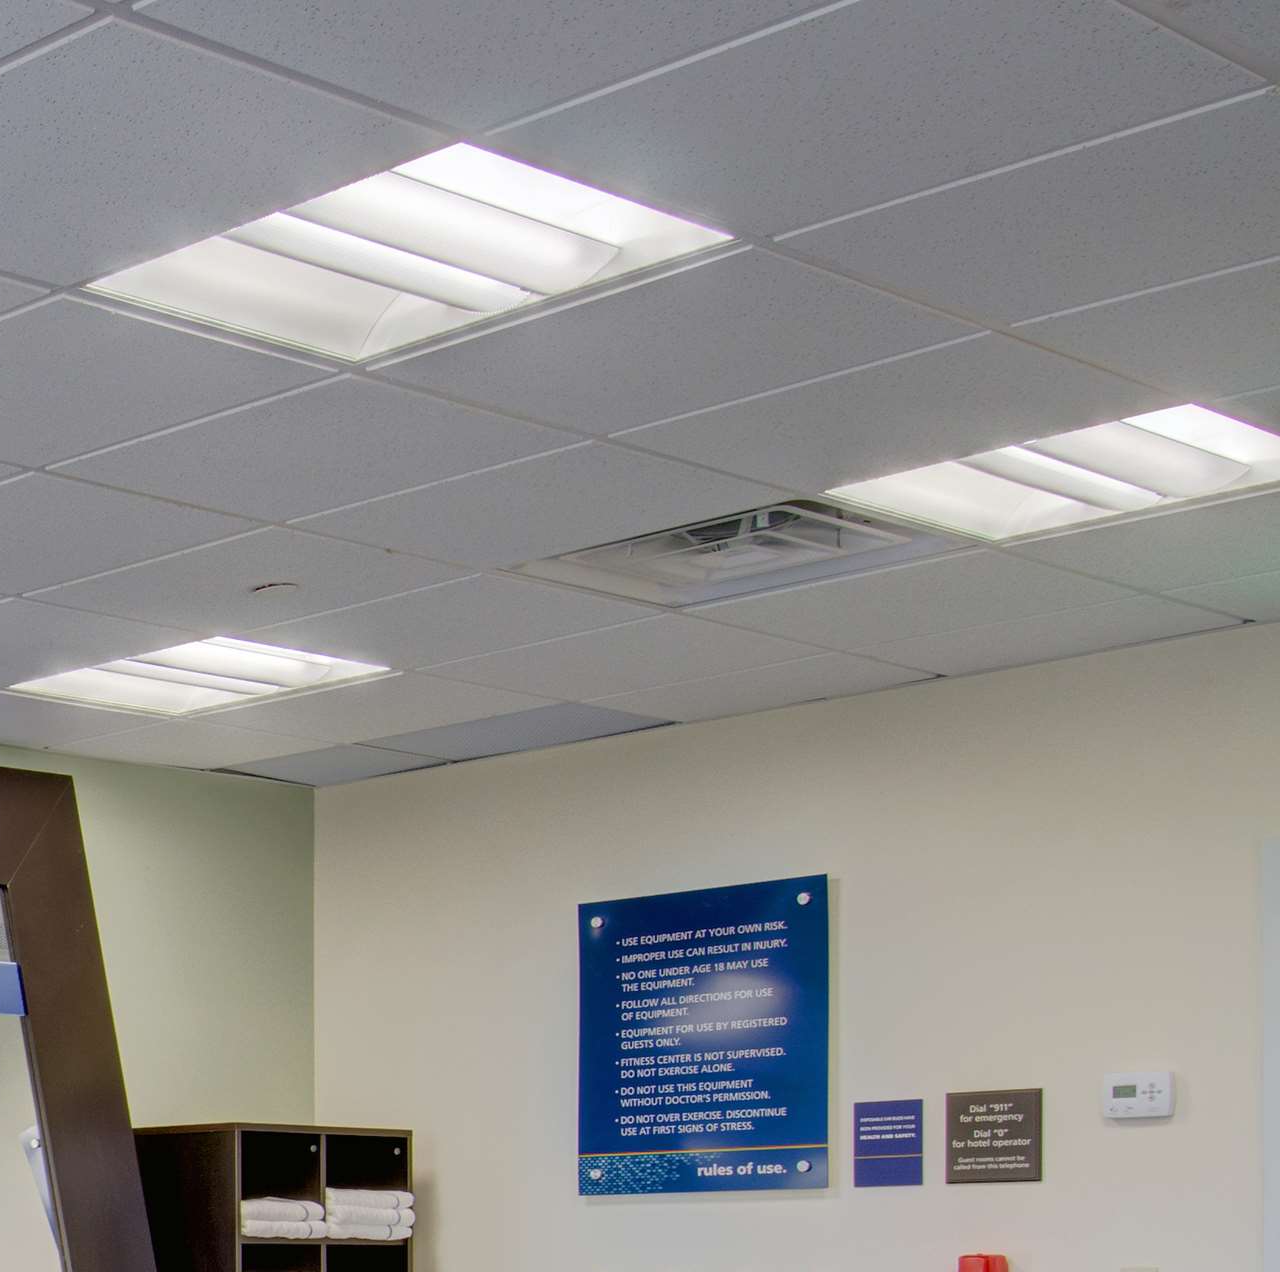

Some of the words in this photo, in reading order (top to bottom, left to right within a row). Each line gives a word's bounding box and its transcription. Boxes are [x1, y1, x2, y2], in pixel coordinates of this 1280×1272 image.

[622, 937, 639, 946] USE
[641, 931, 693, 945] EQUIPMENT
[695, 929, 707, 938] AT
[709, 927, 736, 937] YOUR
[737, 924, 762, 934] OWN
[764, 921, 788, 931] RISK.
[622, 951, 666, 964] IMPROPER
[668, 949, 685, 959] USE
[686, 947, 705, 957] CAN
[707, 943, 739, 955] RESULT
[742, 942, 751, 952] IN
[754, 938, 788, 950] INJURY.
[622, 971, 636, 981] NO
[637, 969, 657, 979] ONE
[659, 966, 690, 977] UNDER
[692, 963, 711, 974] AGE
[714, 962, 725, 972] 18
[727, 960, 748, 970] MAY
[751, 958, 769, 968] USE
[622, 983, 639, 993] THE
[641, 977, 695, 991] EQUIPMENT.
[622, 998, 659, 1009] FOLLOW
[661, 996, 677, 1006] ALL
[679, 991, 732, 1004] DIRECTIONS
[735, 989, 753, 999] FOR
[755, 987, 774, 997] USE
[621, 1012, 633, 1021] OF
[635, 1007, 689, 1020] EQUIPMENT.
[621, 1025, 674, 1039] EQUIPMENT
[676, 1024, 694, 1033] FOR
[696, 1022, 714, 1032] USE
[716, 1021, 729, 1030] BY
[731, 1016, 788, 1029] REGISTERED
[621, 1040, 654, 1050] GUESTS
[656, 1037, 681, 1047] ONLY.
[621, 1056, 655, 1067] FITNESS
[657, 1053, 692, 1064] CENTER
[694, 1053, 702, 1062] IS
[704, 1051, 725, 1061] NOT
[727, 1047, 787, 1060] SUPERVISED.
[621, 1070, 635, 1079] DO
[637, 1068, 657, 1078] NOT
[658, 1064, 699, 1076] EXERCISE
[701, 1063, 735, 1073] ALONE.
[621, 1086, 635, 1096] DO
[636, 1085, 656, 1095] NOT
[658, 1084, 675, 1093] USE
[677, 1082, 697, 1092] THIS
[699, 1079, 753, 1092] EQUIPMENT
[621, 1096, 664, 1108] WITHOUT
[665, 1093, 711, 1105] DOCTOR'S
[713, 1090, 771, 1102] PERMISSION.
[621, 1115, 635, 1125] DO
[636, 1114, 656, 1124] NOT
[657, 1112, 681, 1123] OVER
[682, 1110, 724, 1121] EXERCISE.
[726, 1107, 787, 1119] DISCONTINUE
[969, 1104, 987, 1113] Dial
[960, 1114, 973, 1123] for
[975, 1113, 1024, 1123] emergency
[621, 1127, 637, 1137] USE
[639, 1126, 651, 1135] AT
[652, 1125, 676, 1135] FIRST
[678, 1123, 704, 1133] SIGNS
[706, 1123, 718, 1132] OF
[720, 1121, 755, 1131] STRESS.
[973, 1129, 991, 1138] Dial
[952, 1140, 965, 1148] for
[967, 1138, 990, 1148] hotel
[992, 1138, 1031, 1148] operator
[697, 1163, 733, 1177] rules
[737, 1161, 753, 1175] of
[757, 1163, 787, 1174] use.
[999, 1162, 1030, 1170] telephone
